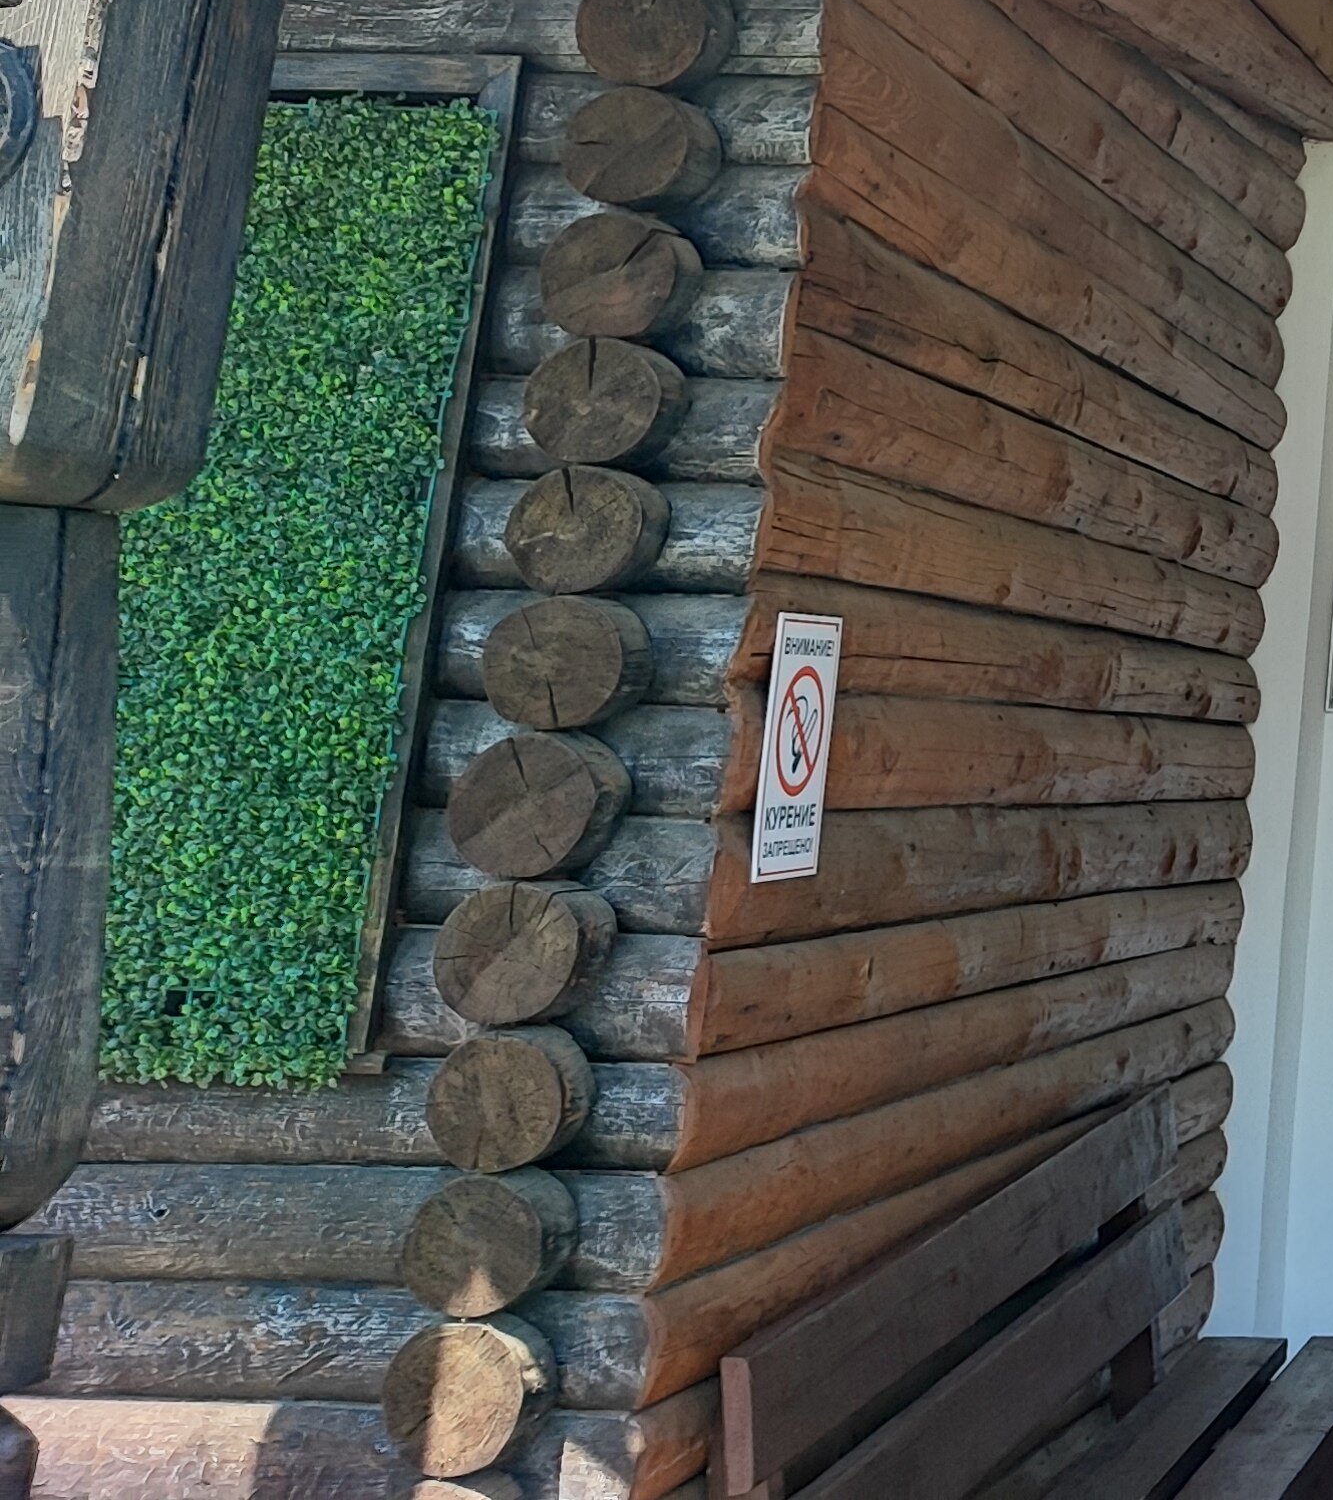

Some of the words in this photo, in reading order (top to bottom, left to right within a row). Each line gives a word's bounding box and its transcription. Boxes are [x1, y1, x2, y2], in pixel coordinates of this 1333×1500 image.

[784, 636, 834, 657] ВНИМАНИЕ!
[764, 803, 817, 831] КУРЕНИЕ
[762, 836, 814, 858] ЗАПРЕЩЕНО!
